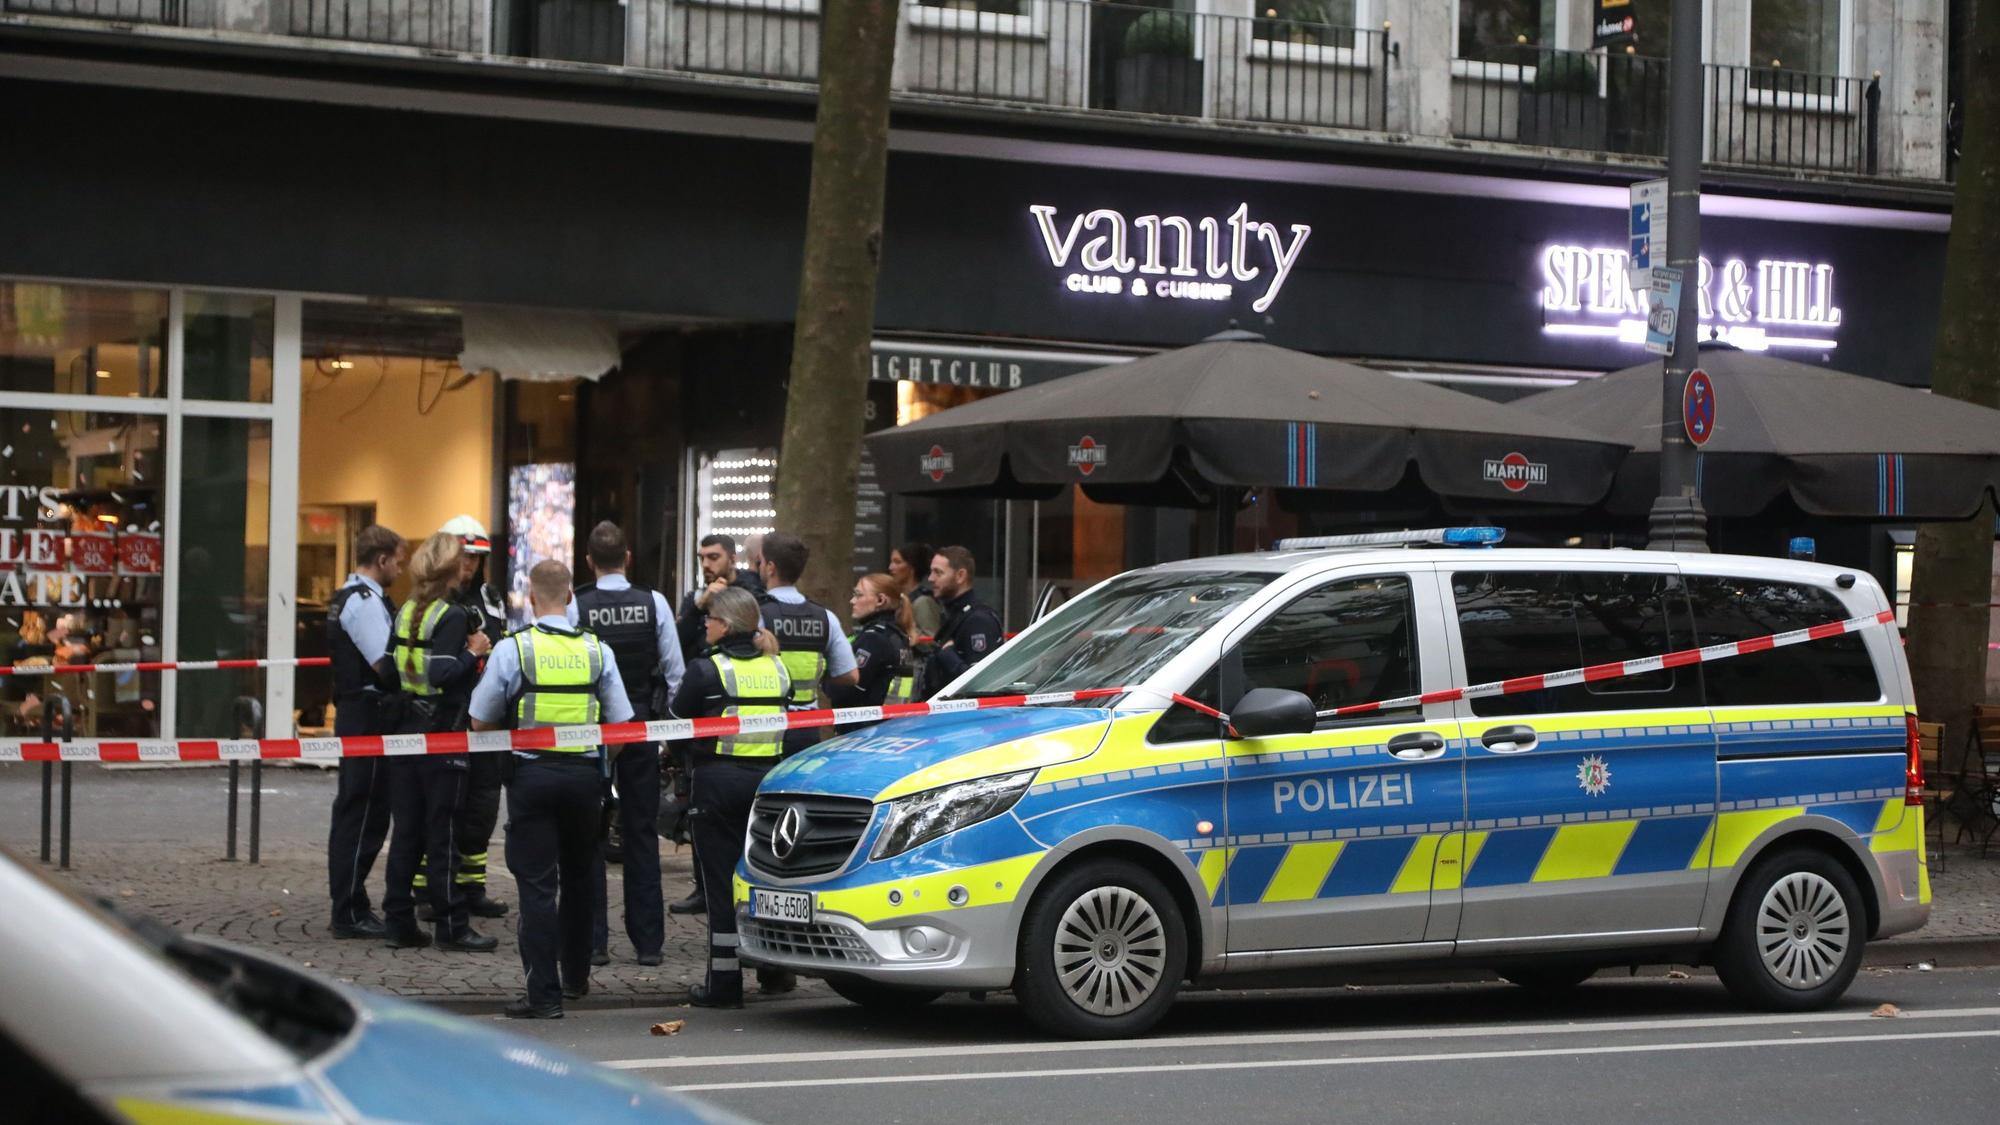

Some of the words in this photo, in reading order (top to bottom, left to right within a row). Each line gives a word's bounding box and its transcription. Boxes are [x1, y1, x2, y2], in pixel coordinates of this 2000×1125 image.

[1067, 274, 1122, 293] CLUB
[1132, 278, 1148, 296] &
[1544, 246, 1714, 320] SPENR
[1724, 259, 1752, 322] &
[1758, 260, 1841, 326] HILL
[872, 356, 1022, 387] IGHTCLUB
[1486, 463, 1543, 481] MARTINI
[589, 606, 649, 626] POLIZEI
[773, 618, 824, 637] POLIZEI
[539, 655, 586, 669] POLIZEI
[738, 674, 778, 690] POLIZEI
[1274, 773, 1414, 814] POLIZEI
[774, 896, 809, 919] 5-6508
